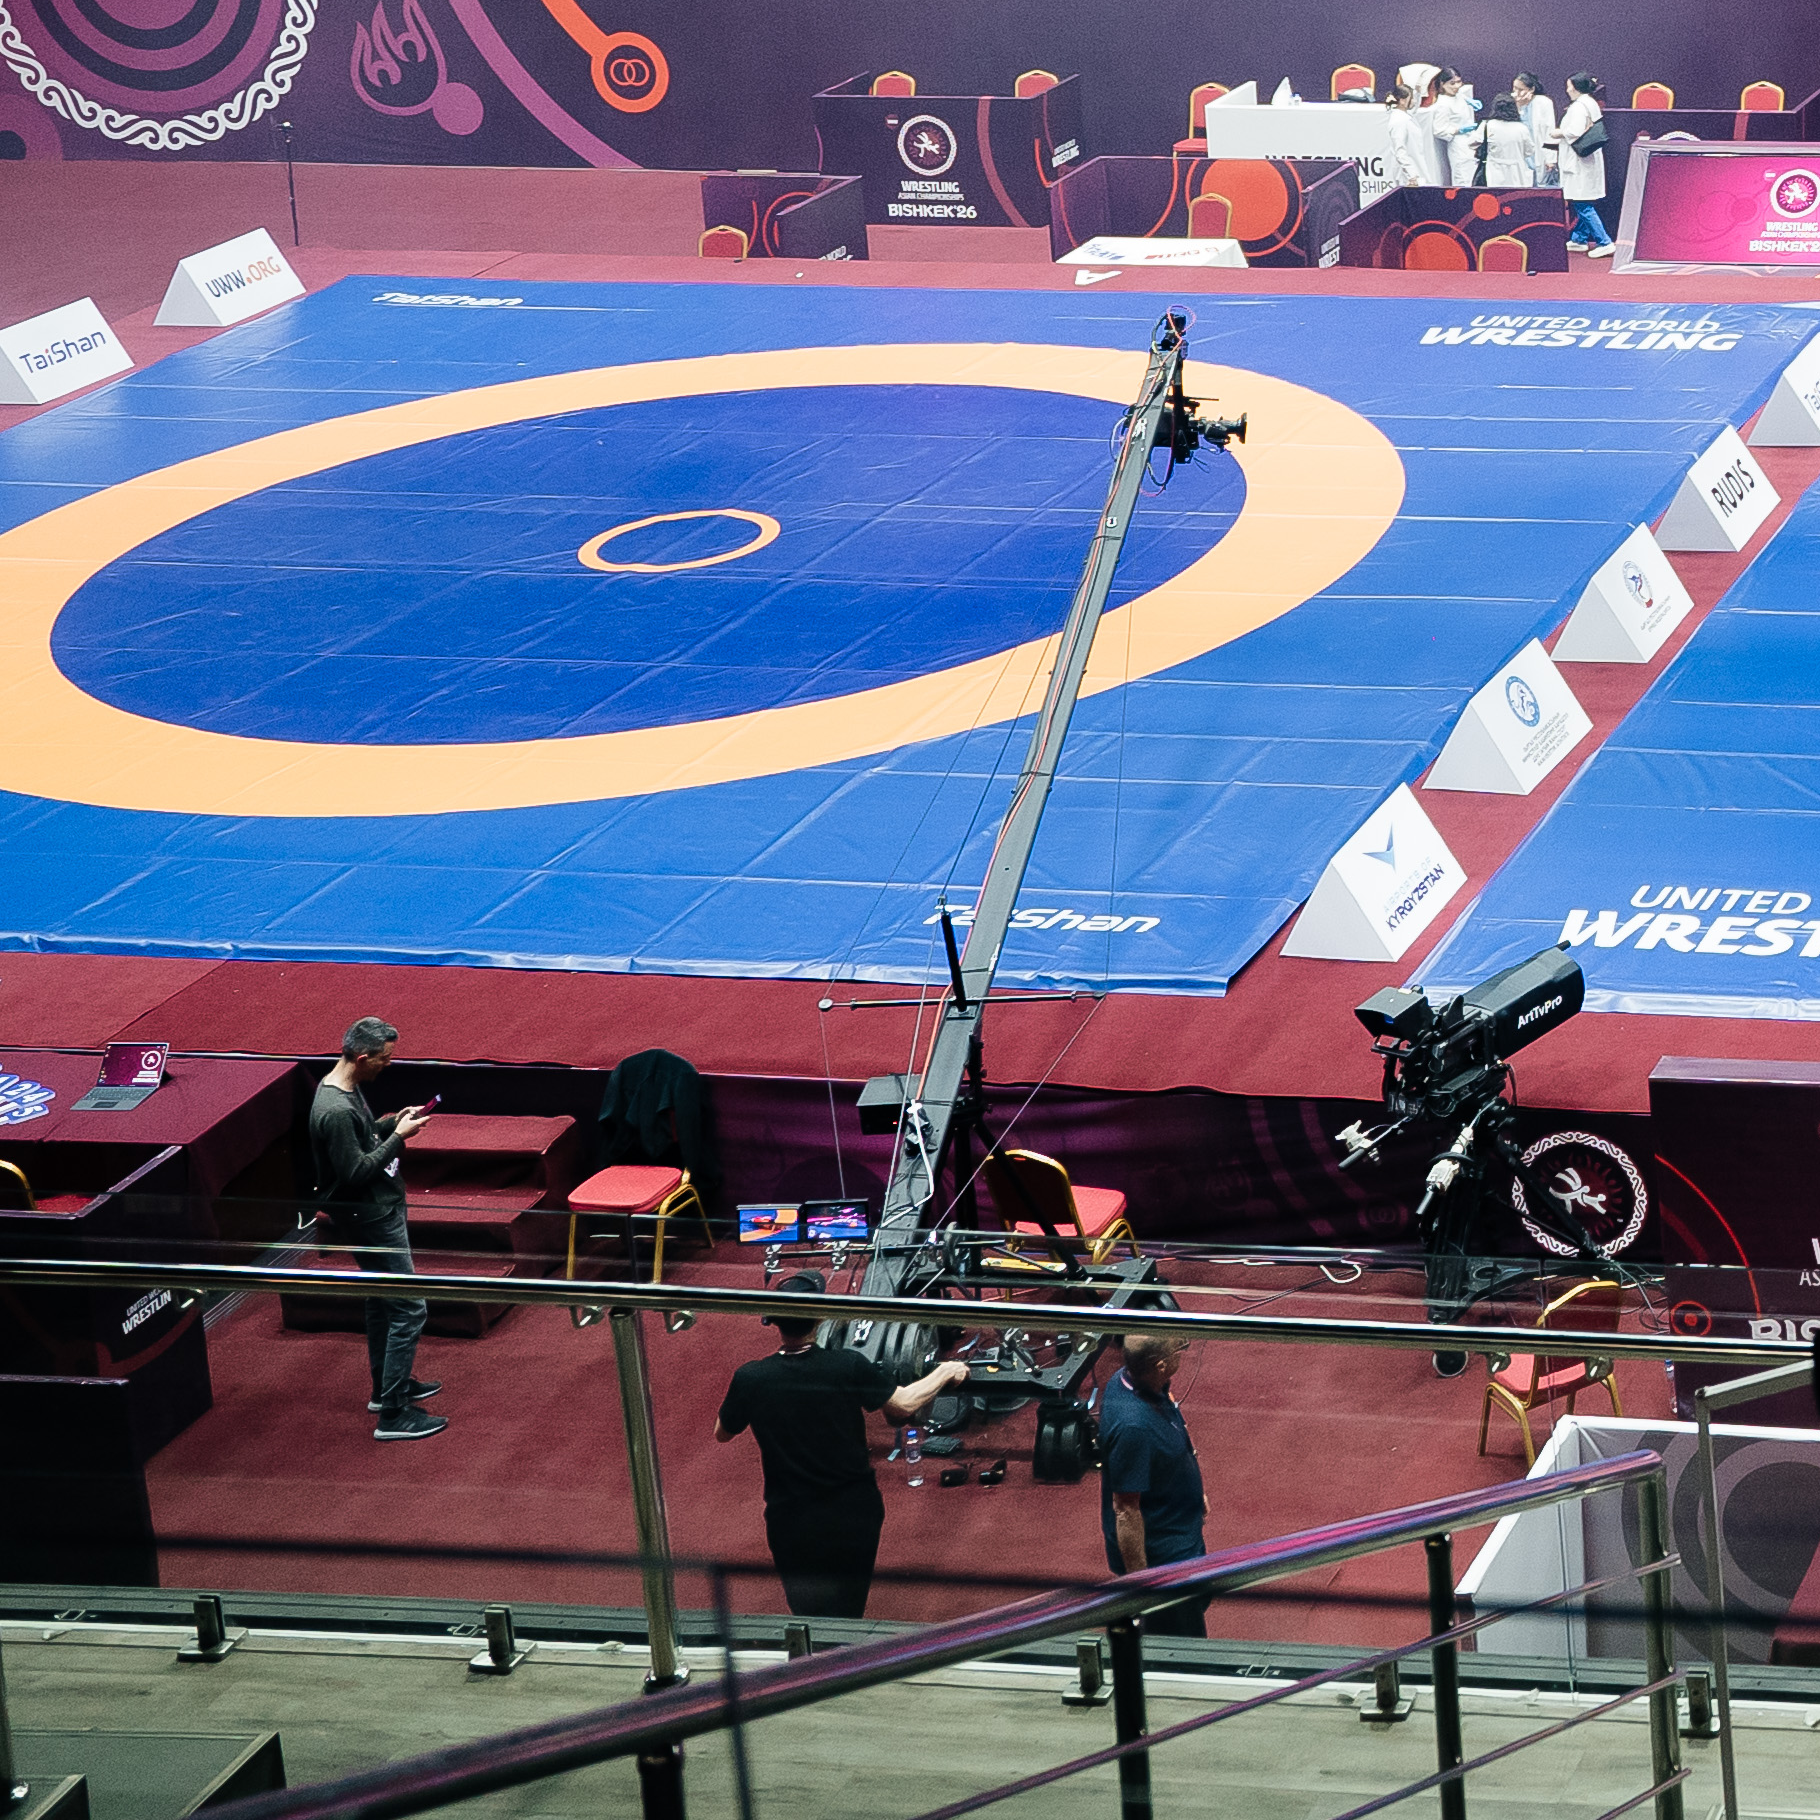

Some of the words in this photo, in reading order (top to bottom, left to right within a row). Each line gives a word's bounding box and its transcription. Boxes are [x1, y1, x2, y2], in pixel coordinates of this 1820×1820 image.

[901, 181, 960, 193] WRESTLING
[887, 204, 978, 218] BISHKEK'26
[1766, 222, 1819, 232] WRESTLING
[205, 257, 282, 298] UWW.ORG
[372, 292, 523, 306] TaiShan
[1420, 328, 1744, 353] WRESTLING
[1471, 315, 1567, 332] UNITED
[1580, 316, 1722, 334] WORLD
[18, 329, 106, 373] TaiShan
[1711, 458, 1755, 518] RUDIS
[1385, 863, 1446, 932] KYRGYZSTAN
[1630, 883, 1820, 919] UNITED
[924, 903, 1160, 934] TaShan
[1518, 995, 1563, 1030] ArtTvPro
[122, 1289, 172, 1335] WRESTLIN
